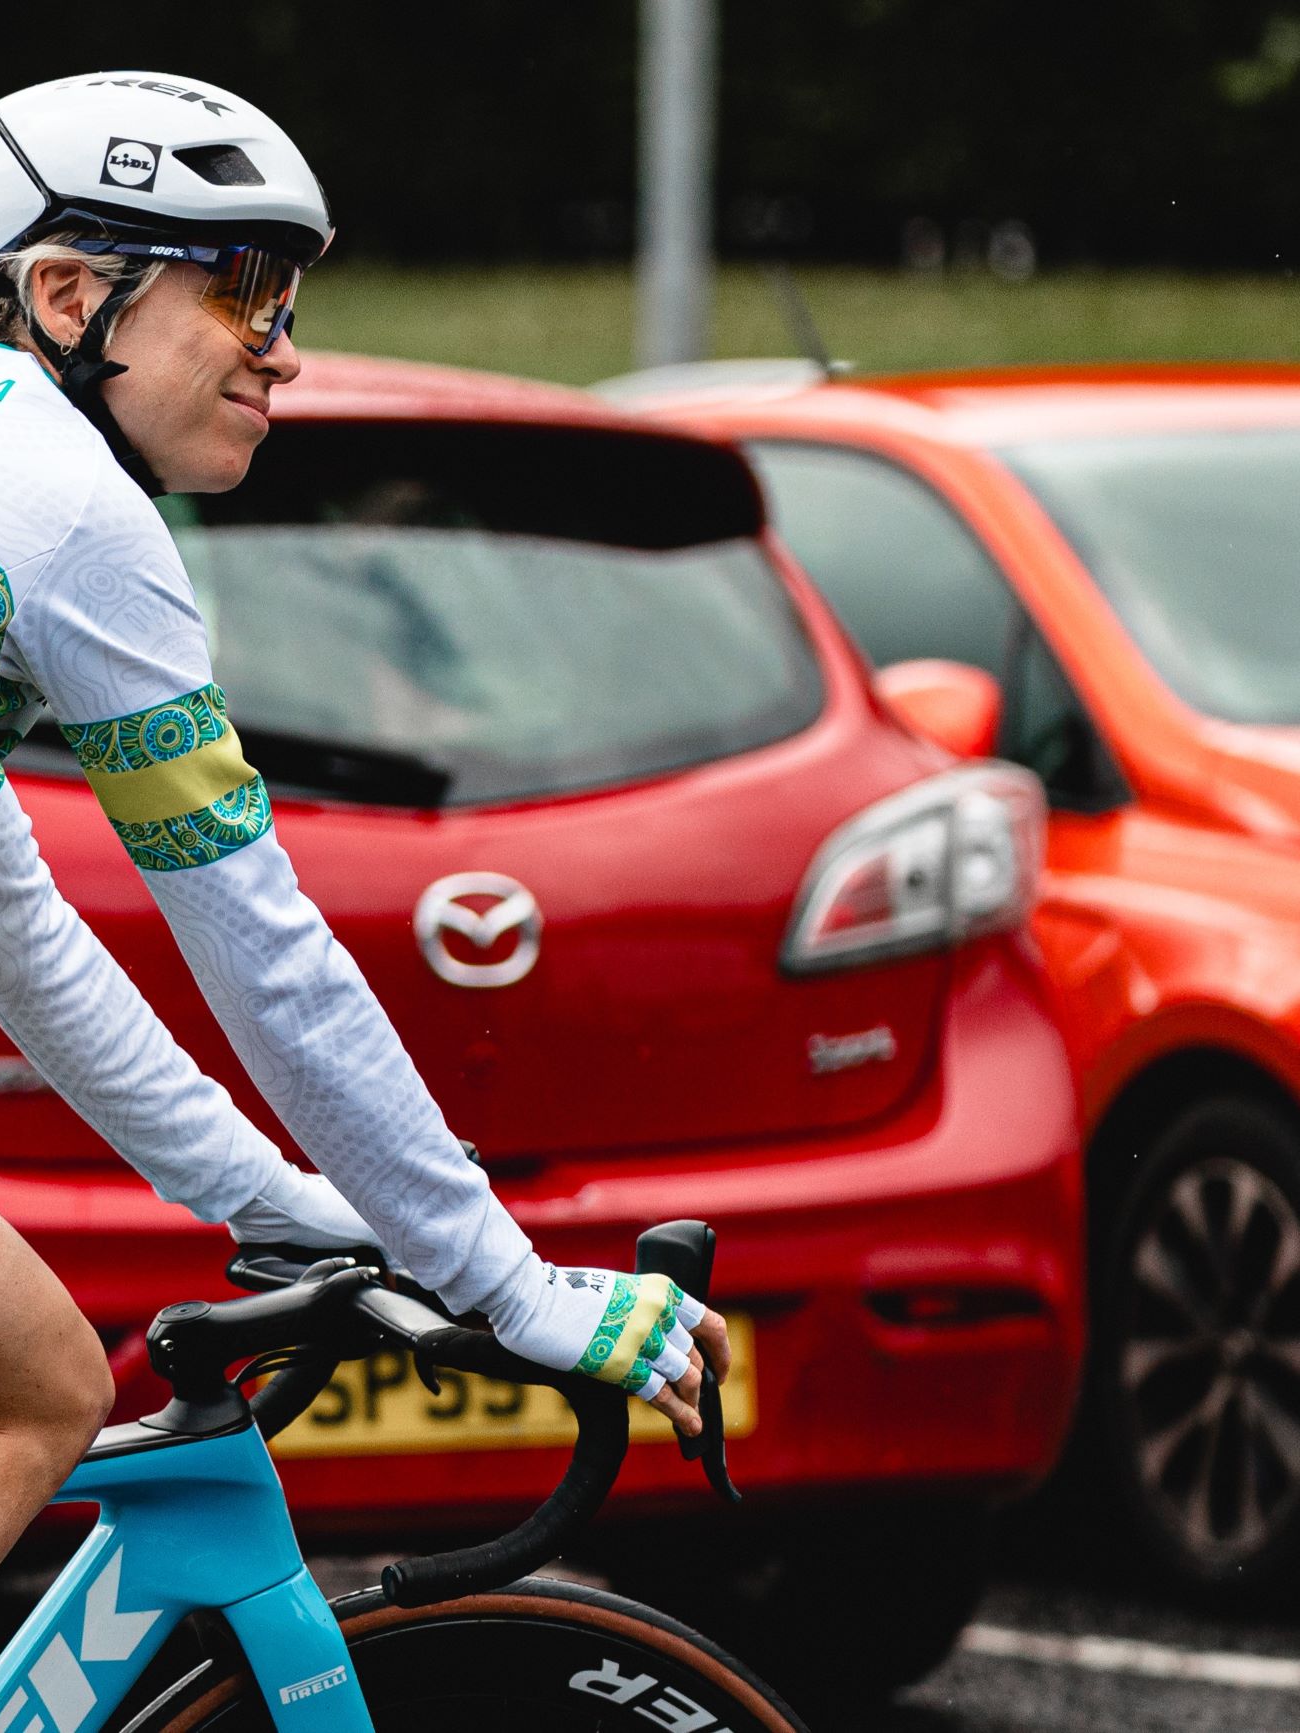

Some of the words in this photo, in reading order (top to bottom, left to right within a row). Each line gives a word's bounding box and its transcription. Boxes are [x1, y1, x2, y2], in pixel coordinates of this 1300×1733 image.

[149, 245, 185, 258] 100%
[590, 1273, 606, 1294] AIS
[279, 1665, 348, 1705] PIRELLI
